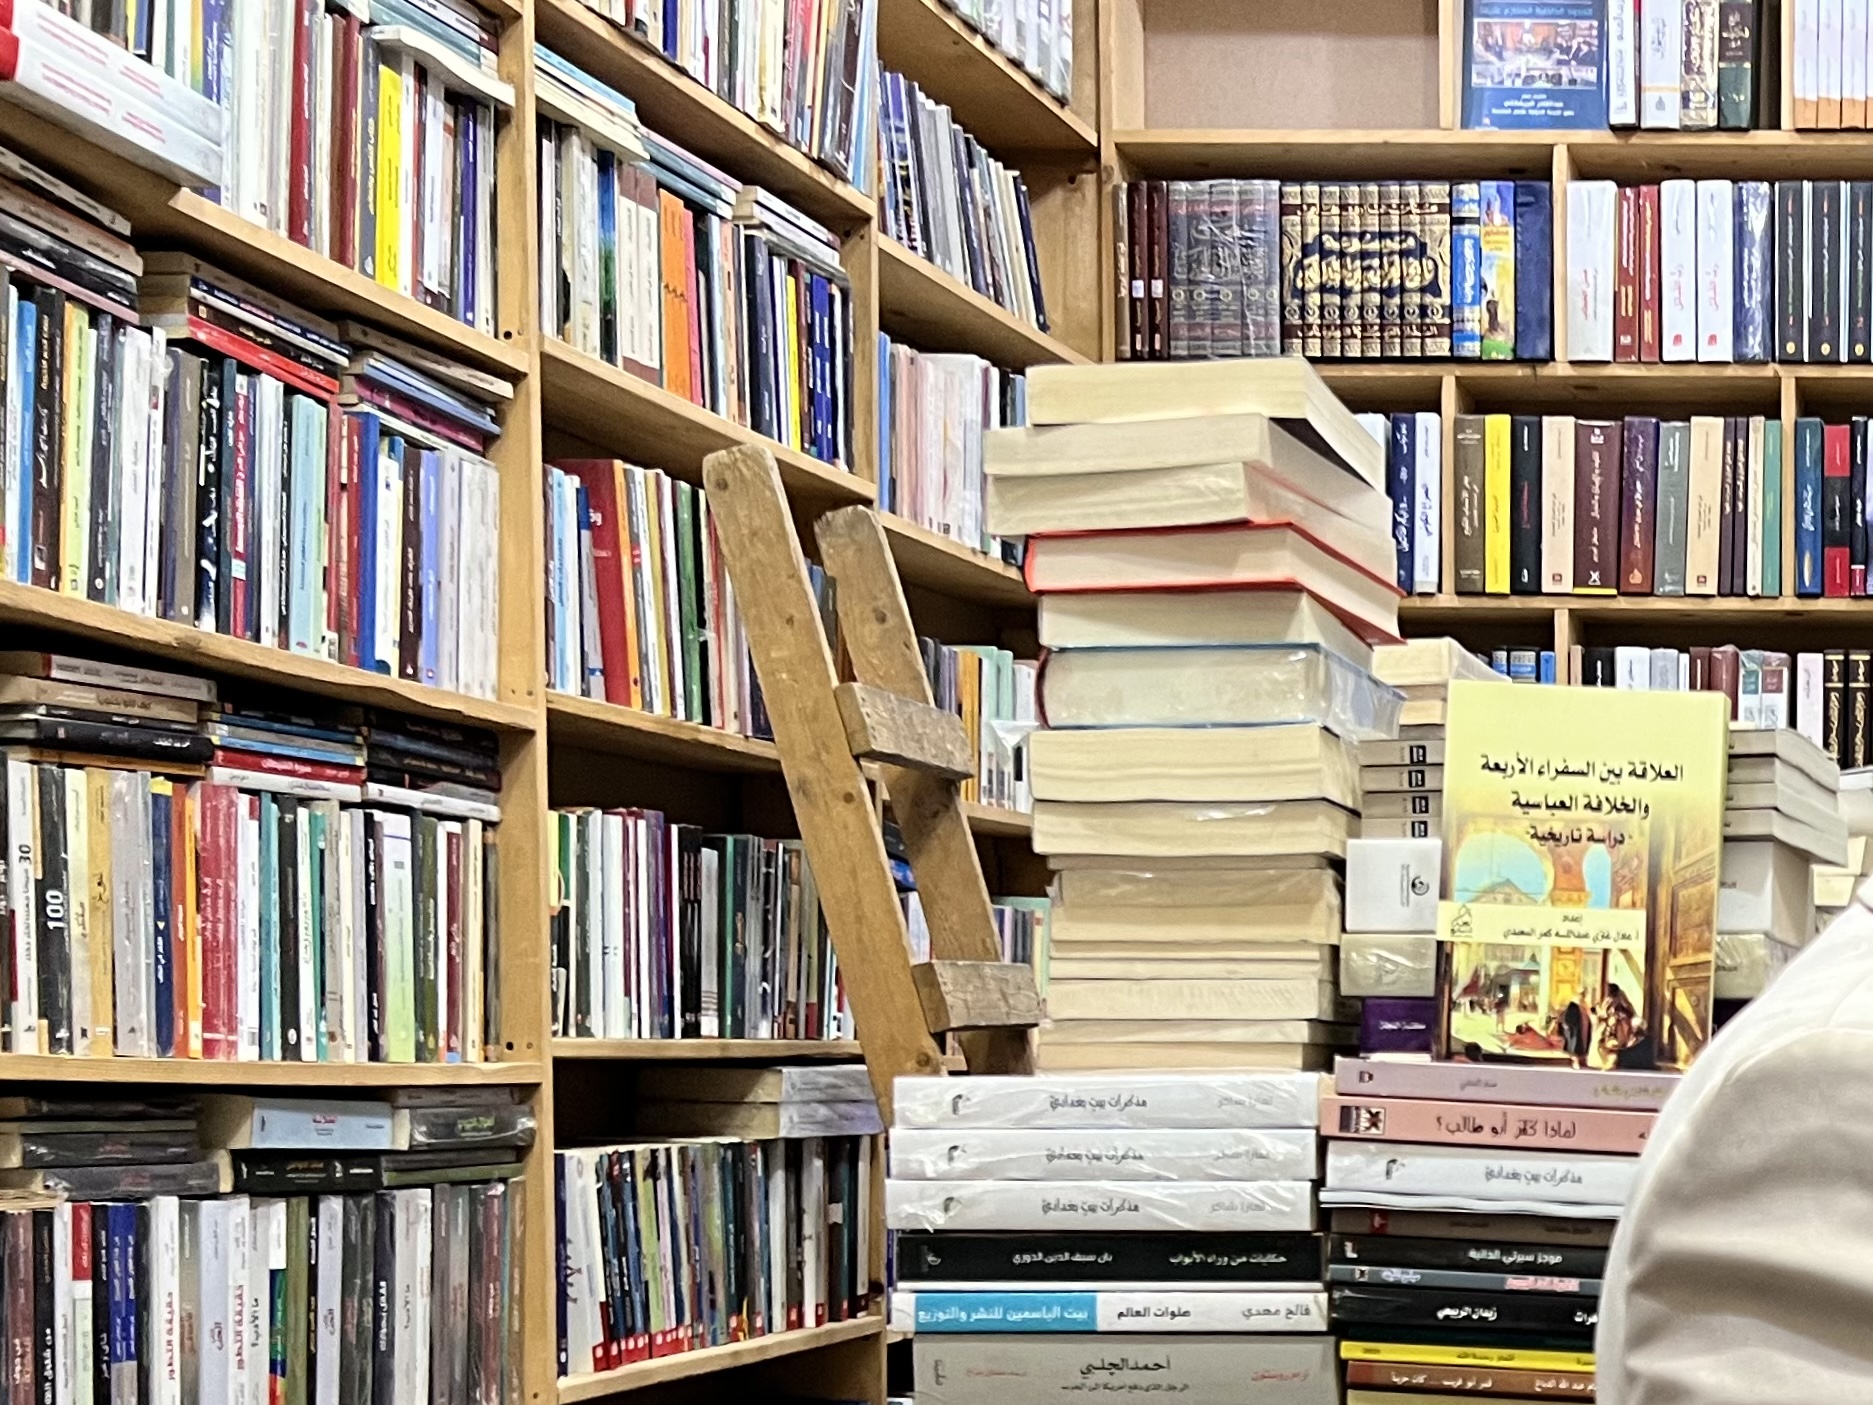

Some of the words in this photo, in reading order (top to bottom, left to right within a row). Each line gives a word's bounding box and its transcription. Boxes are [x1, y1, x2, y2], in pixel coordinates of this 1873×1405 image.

[1481, 752, 1534, 780] الأربعة
[1538, 762, 1595, 782] السفراء
[1599, 763, 1623, 785] بين
[1628, 764, 1684, 782] العلاقة
[1512, 791, 1578, 817] العباسية
[1583, 792, 1650, 820] والخلافة
[45, 889, 65, 931] 100
[1544, 1119, 1576, 1139] لماذا
